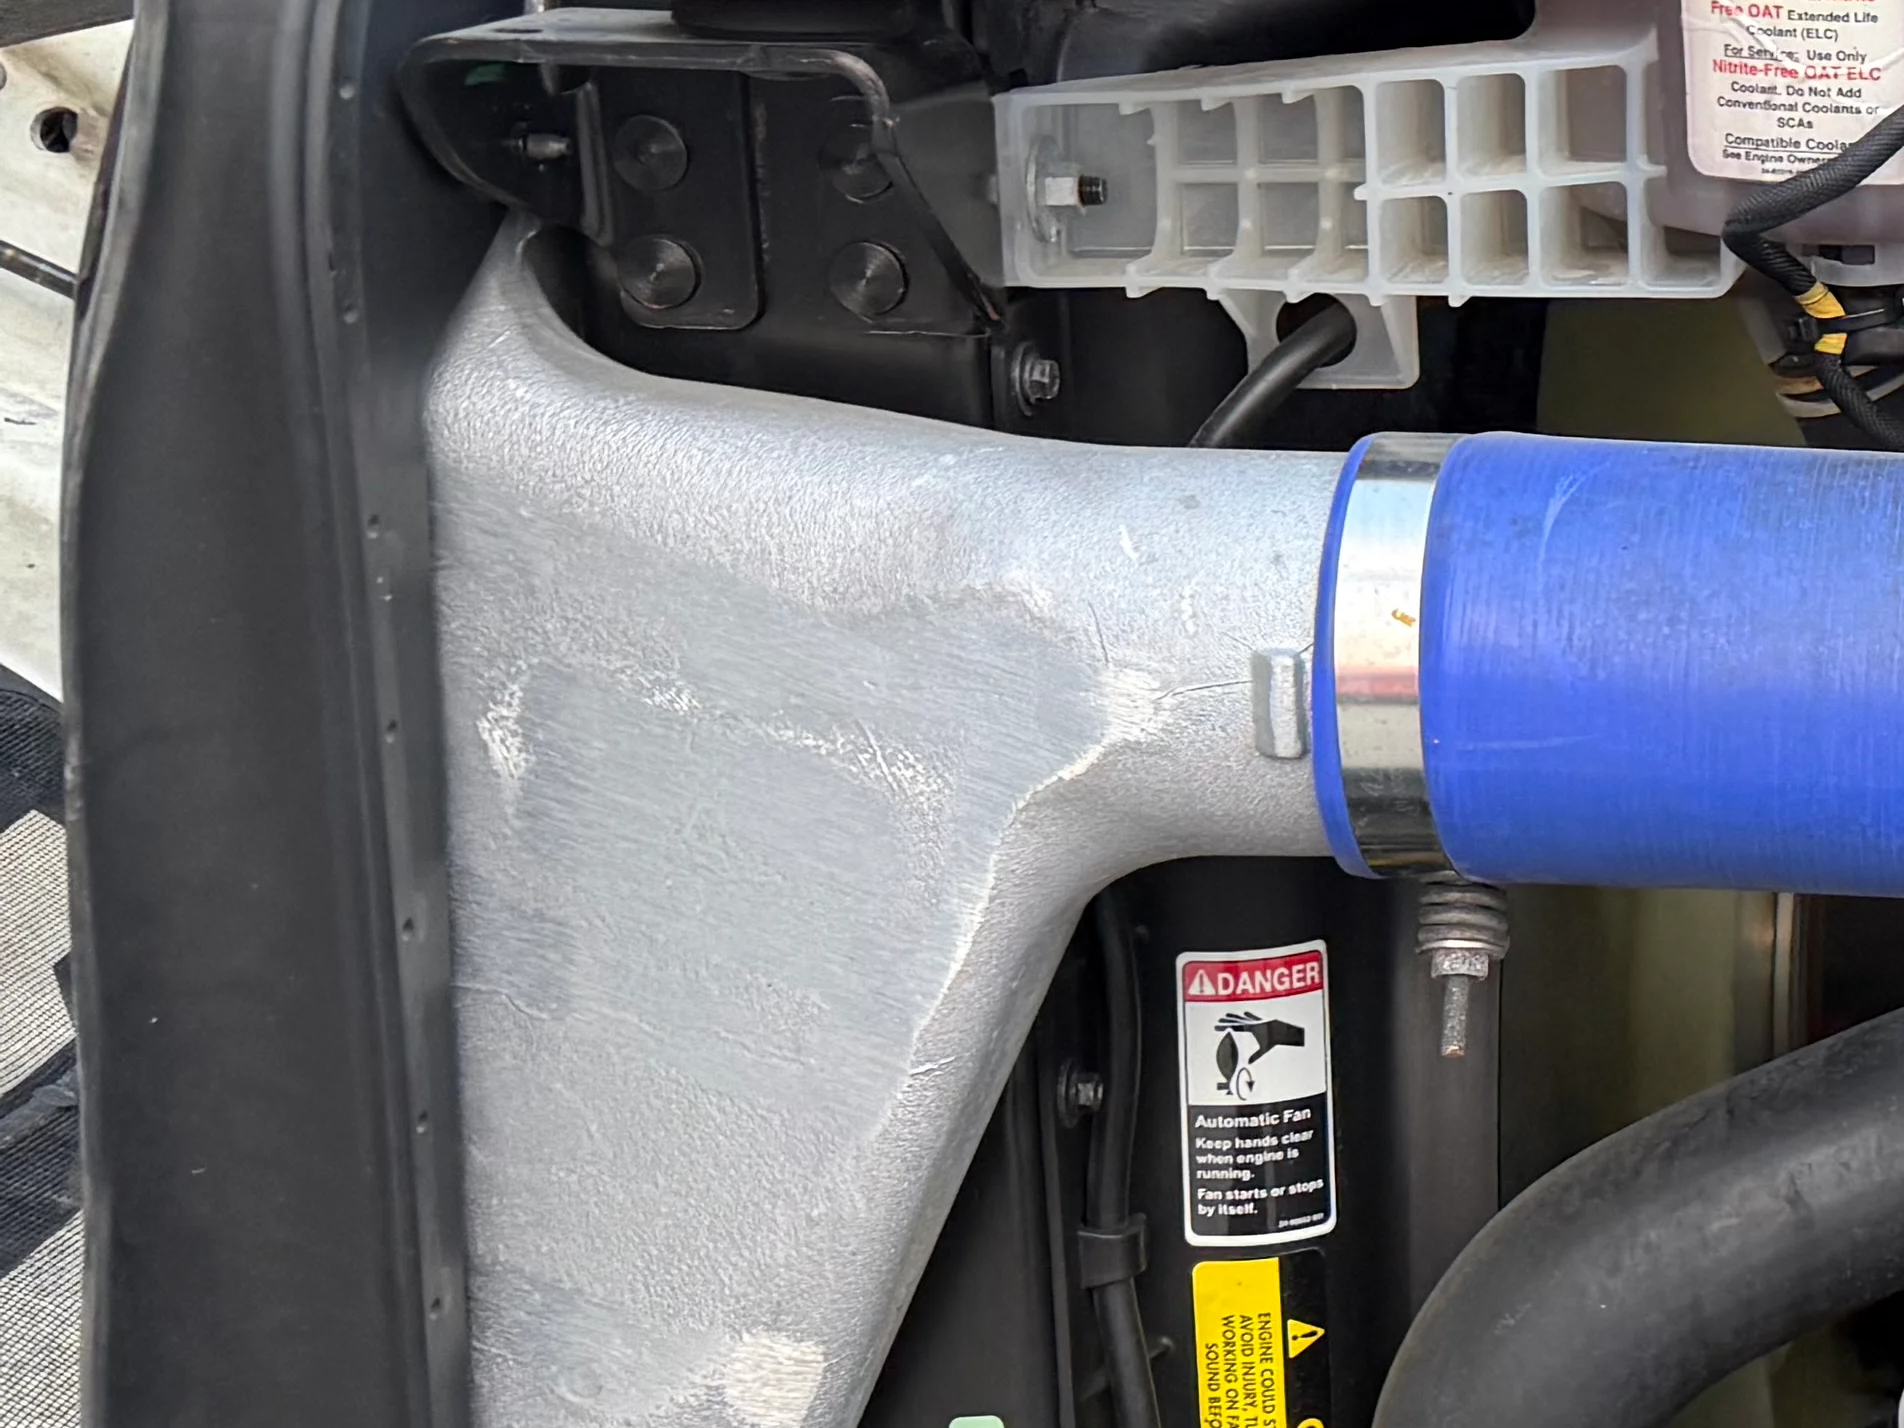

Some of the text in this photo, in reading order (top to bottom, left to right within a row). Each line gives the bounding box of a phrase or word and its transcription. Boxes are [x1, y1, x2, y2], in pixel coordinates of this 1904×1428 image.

[1748, 3, 1784, 19] OAT
[1787, 9, 1850, 24] Extended
[1854, 12, 1879, 24] Life
[1801, 27, 1839, 42] (ELC)
[1724, 44, 1867, 65] For Use Only
[1712, 59, 1799, 80] Nitrite-Free
[1786, 84, 1805, 96] Do
[1808, 86, 1832, 98] Not
[1836, 87, 1862, 99] Add
[1802, 103, 1862, 115] Coolants
[1866, 106, 1880, 115] or
[1776, 117, 1814, 129] SCAs
[1724, 133, 1800, 150] Compatible
[1744, 151, 1784, 166] Engine
[1216, 961, 1320, 996] DANGER
[1194, 1108, 1312, 1129] Automatic Fan
[1195, 1128, 1314, 1152] Keep hands clear
[1195, 1147, 1299, 1166] when engine is
[1196, 1168, 1255, 1183] running.
[1197, 1177, 1324, 1201] Fan starts or stops
[1197, 1200, 1258, 1218] by itself.
[1239, 1314, 1254, 1358] AVOID
[1257, 1312, 1273, 1363] ENGINE
[1221, 1314, 1237, 1383] WORKING
[1205, 1342, 1220, 1392] SOUND
[1241, 1361, 1258, 1412] INJURY,
[1260, 1368, 1276, 1415] COULD
[1225, 1389, 1238, 1412] ON
